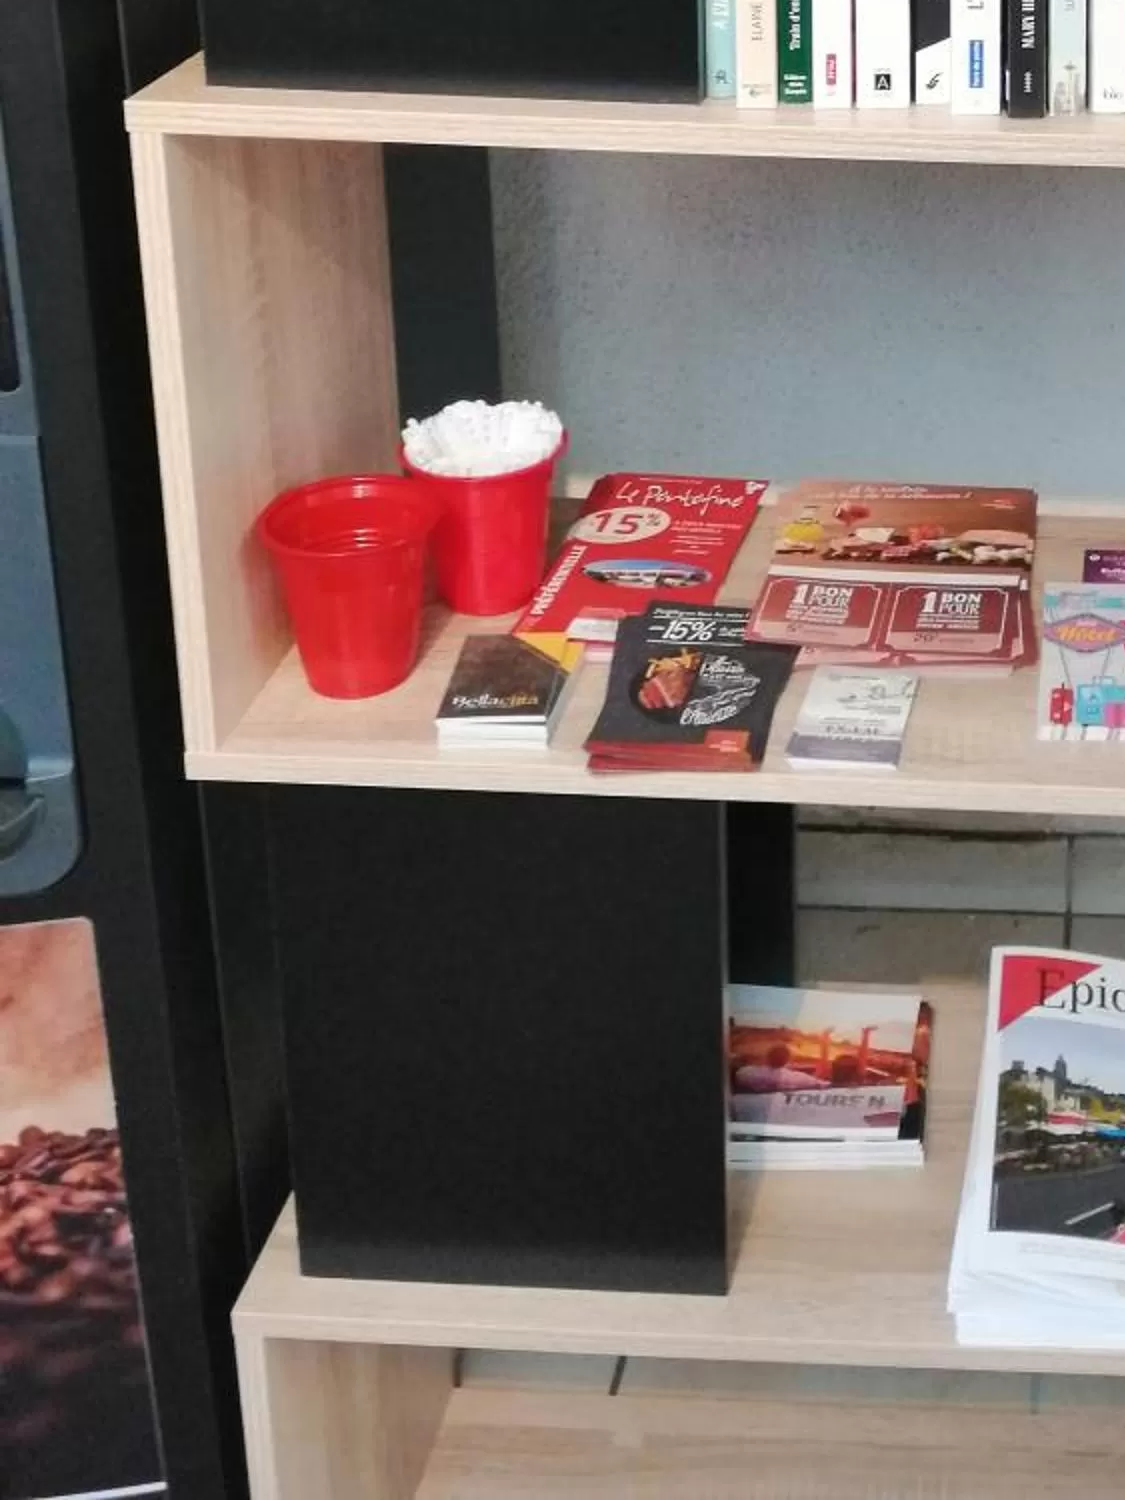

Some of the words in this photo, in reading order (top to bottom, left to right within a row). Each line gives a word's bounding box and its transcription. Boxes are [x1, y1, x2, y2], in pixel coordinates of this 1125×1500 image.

[788, 13, 802, 51] Train
[1021, 14, 1036, 49] MARY
[812, 585, 854, 598] BON
[809, 595, 850, 607] POUR
[921, 591, 937, 613] 1
[940, 592, 983, 604] BON
[938, 602, 981, 616] POUR
[782, 1091, 865, 1109] TOURS
